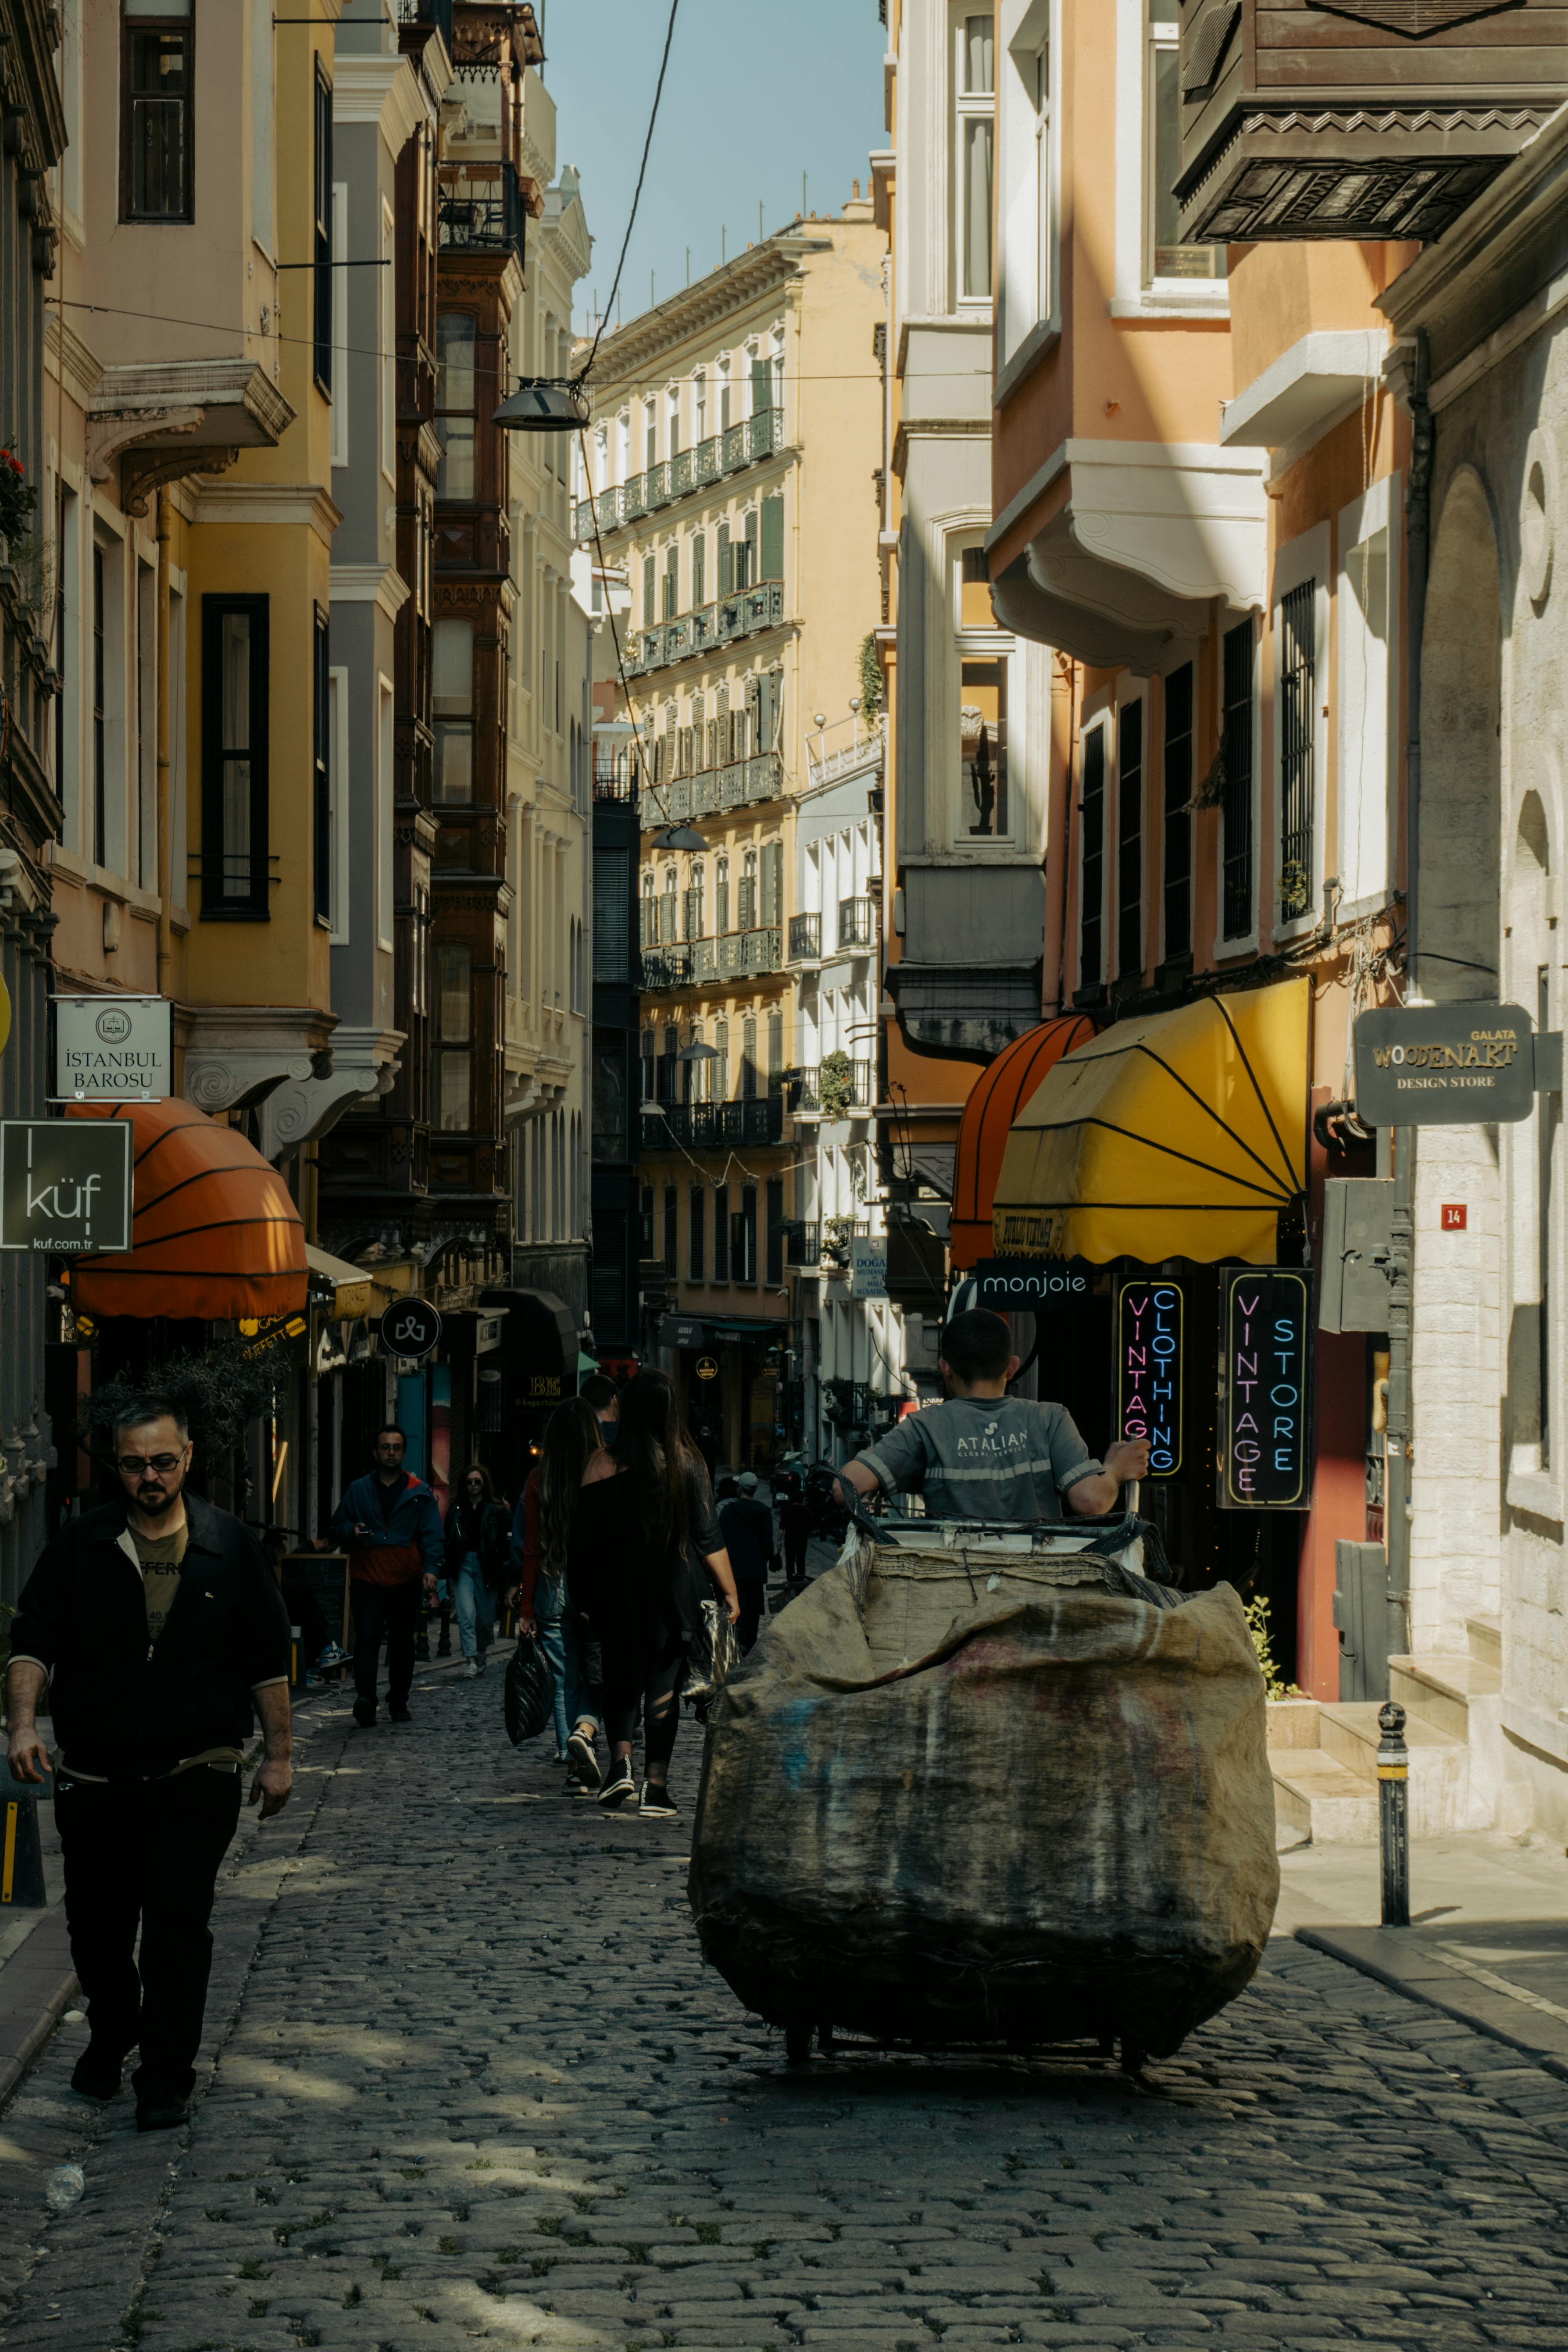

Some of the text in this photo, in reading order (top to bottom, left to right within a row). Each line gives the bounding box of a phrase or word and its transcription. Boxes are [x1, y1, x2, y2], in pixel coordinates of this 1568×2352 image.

[1471, 1030, 1516, 1041] GALATA
[65, 1049, 162, 1068] İSTANBUL
[1373, 1042, 1517, 1068] WOODENART
[74, 1073, 154, 1088] BAROSU
[1397, 1076, 1495, 1089] DESIGN STORE
[27, 1174, 101, 1235] küf
[1447, 1210, 1461, 1224] 14
[33, 1238, 93, 1250] kuf.com.tr
[856, 1257, 887, 1267] DOĞA
[983, 1271, 1086, 1298] monjoie
[529, 1375, 561, 1396] BE
[1125, 1290, 1175, 1468] VINTAG CLOTHING
[1234, 1295, 1298, 1491] VINTAGE STORE
[957, 1429, 1027, 1451] ATALIAN
